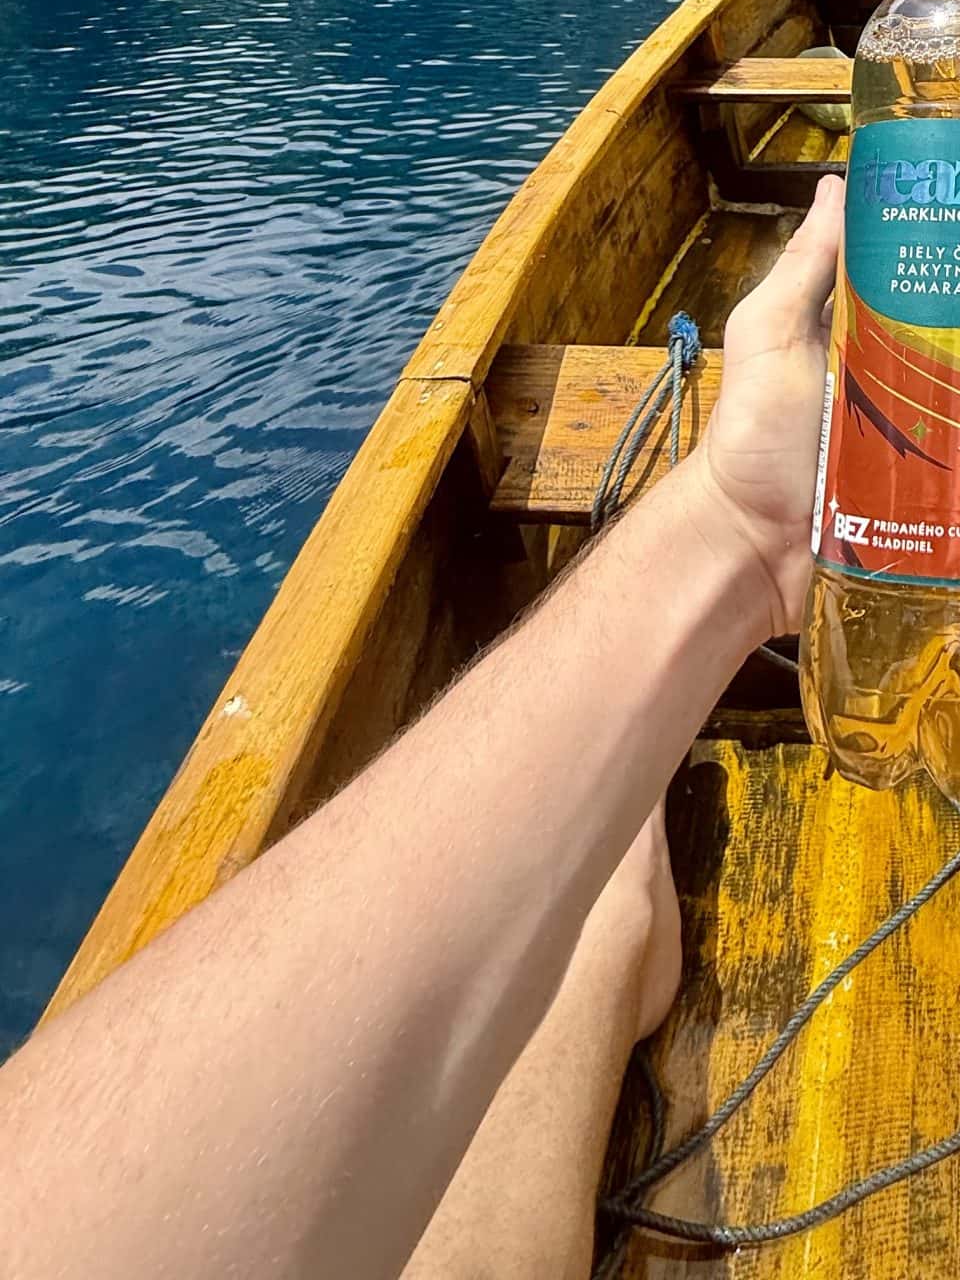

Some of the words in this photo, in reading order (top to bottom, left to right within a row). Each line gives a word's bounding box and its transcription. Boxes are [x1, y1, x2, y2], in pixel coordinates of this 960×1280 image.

[834, 512, 870, 545] BEZ
[873, 520, 945, 537] PRIDANÉHO
[872, 536, 933, 553] SLADIDIEL
